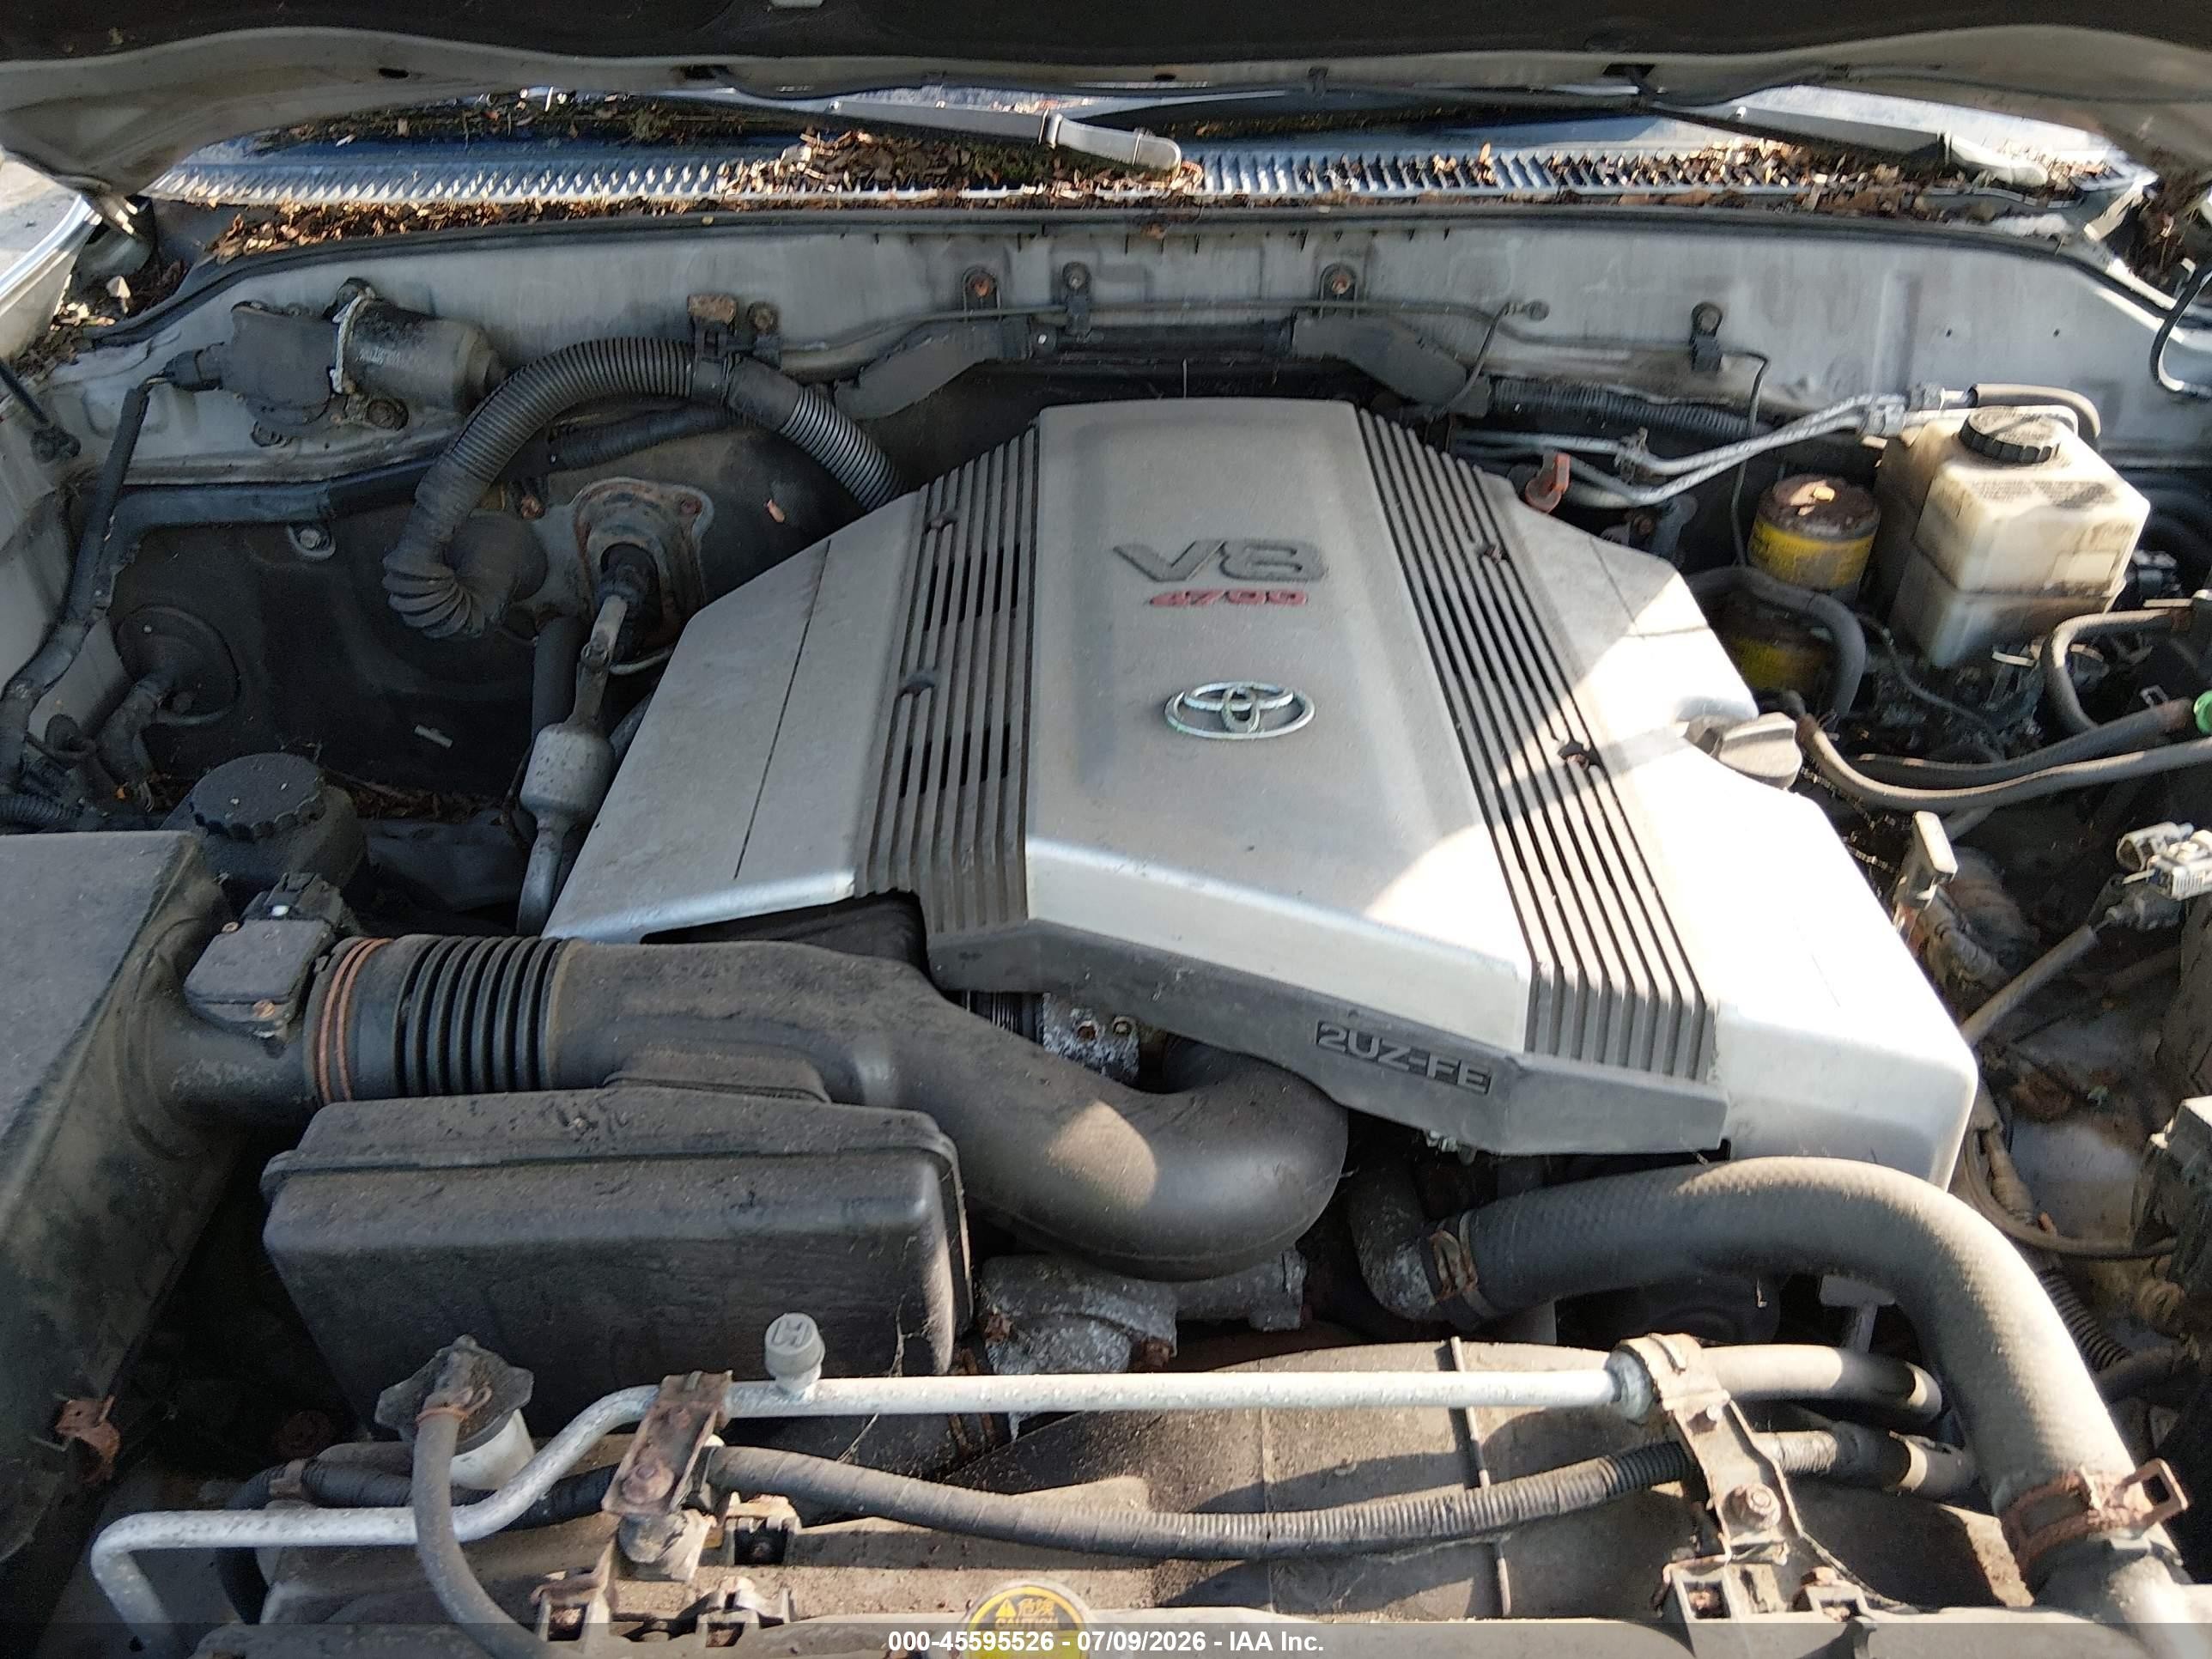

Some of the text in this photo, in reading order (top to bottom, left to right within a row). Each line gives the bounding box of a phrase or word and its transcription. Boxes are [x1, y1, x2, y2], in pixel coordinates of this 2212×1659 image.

[1113, 538, 1328, 583] V8
[1316, 1021, 1492, 1095] 2UZ-FE
[771, 1318, 811, 1348] H
[994, 1616, 1059, 1632] CAUTION
